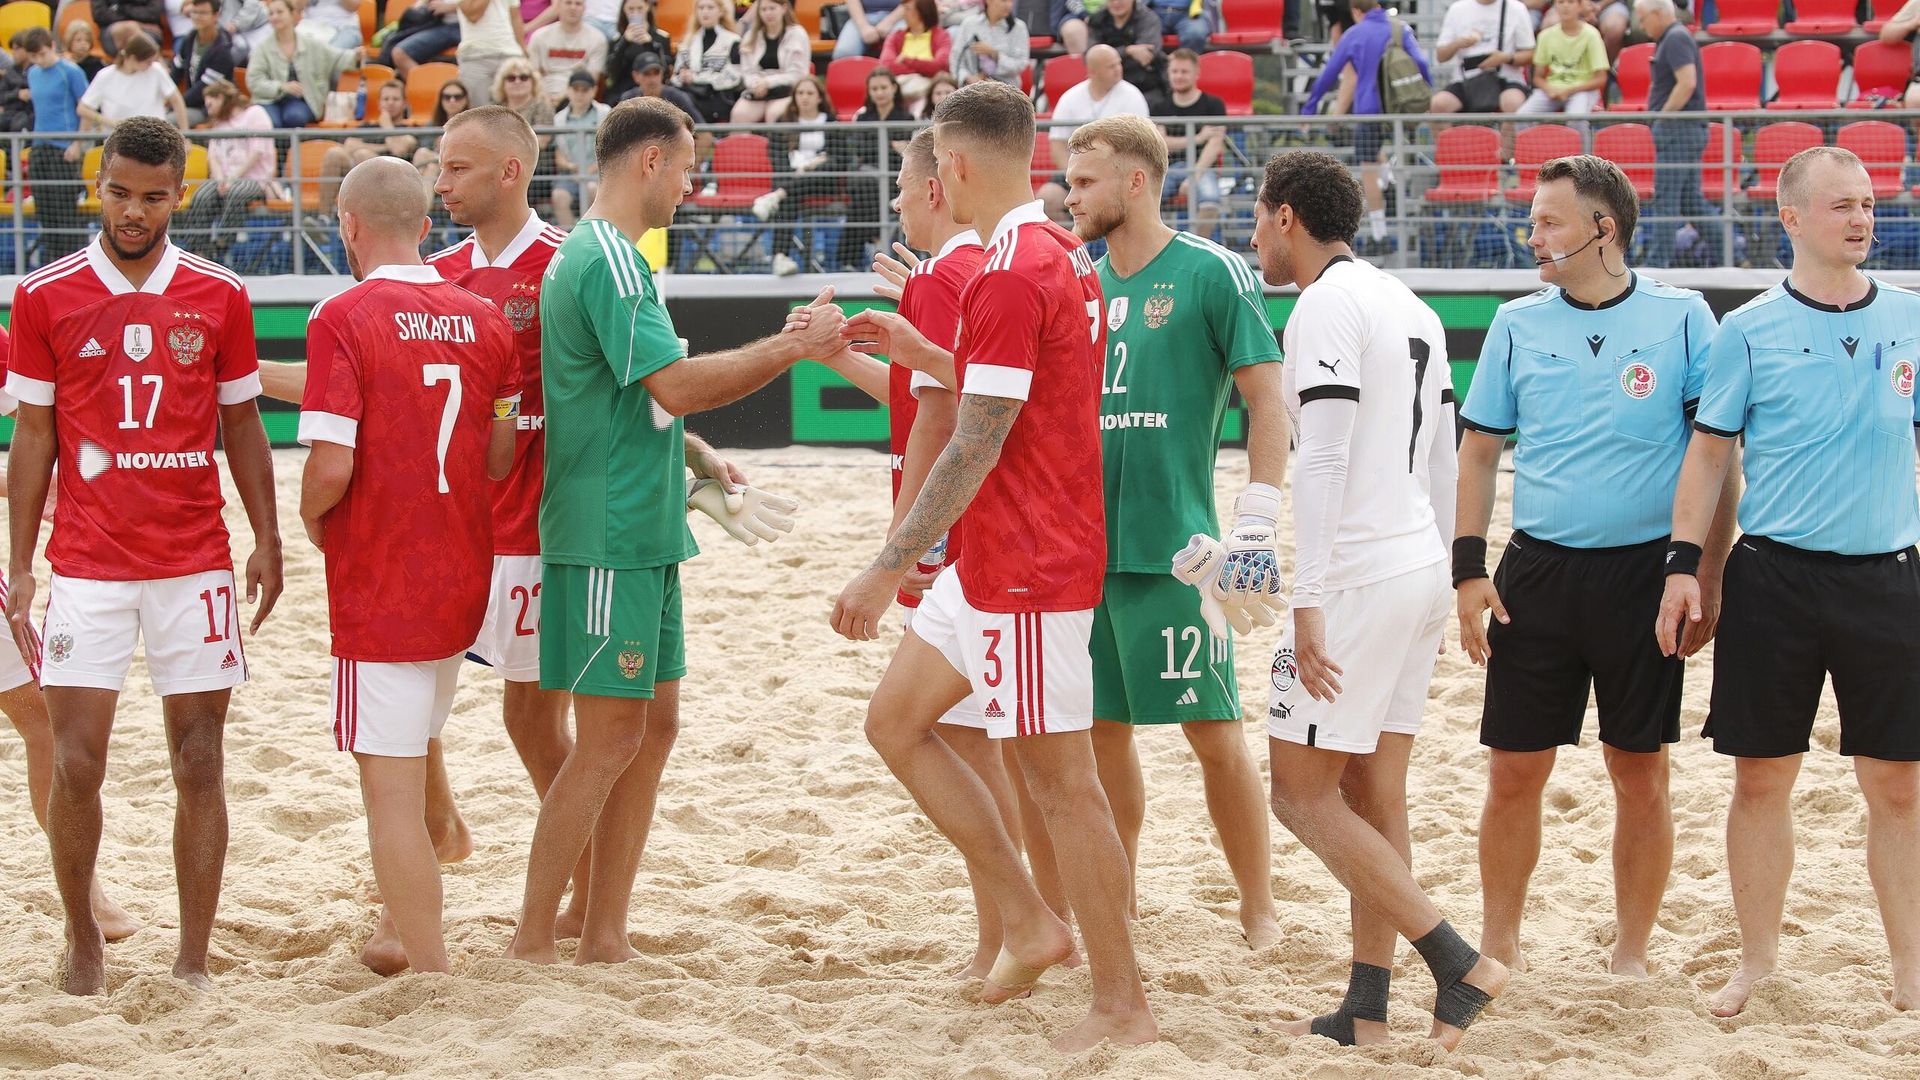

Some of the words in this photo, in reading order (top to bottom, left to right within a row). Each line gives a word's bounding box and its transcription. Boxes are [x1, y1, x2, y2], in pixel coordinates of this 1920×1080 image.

[78, 348, 107, 358] adidas
[394, 312, 477, 343] SHKARIN
[117, 374, 164, 430] 17
[422, 363, 463, 494] 7
[116, 451, 210, 471] NOVATEK
[199, 585, 231, 644] 17
[982, 629, 1003, 688] 3
[1160, 625, 1202, 680] 12
